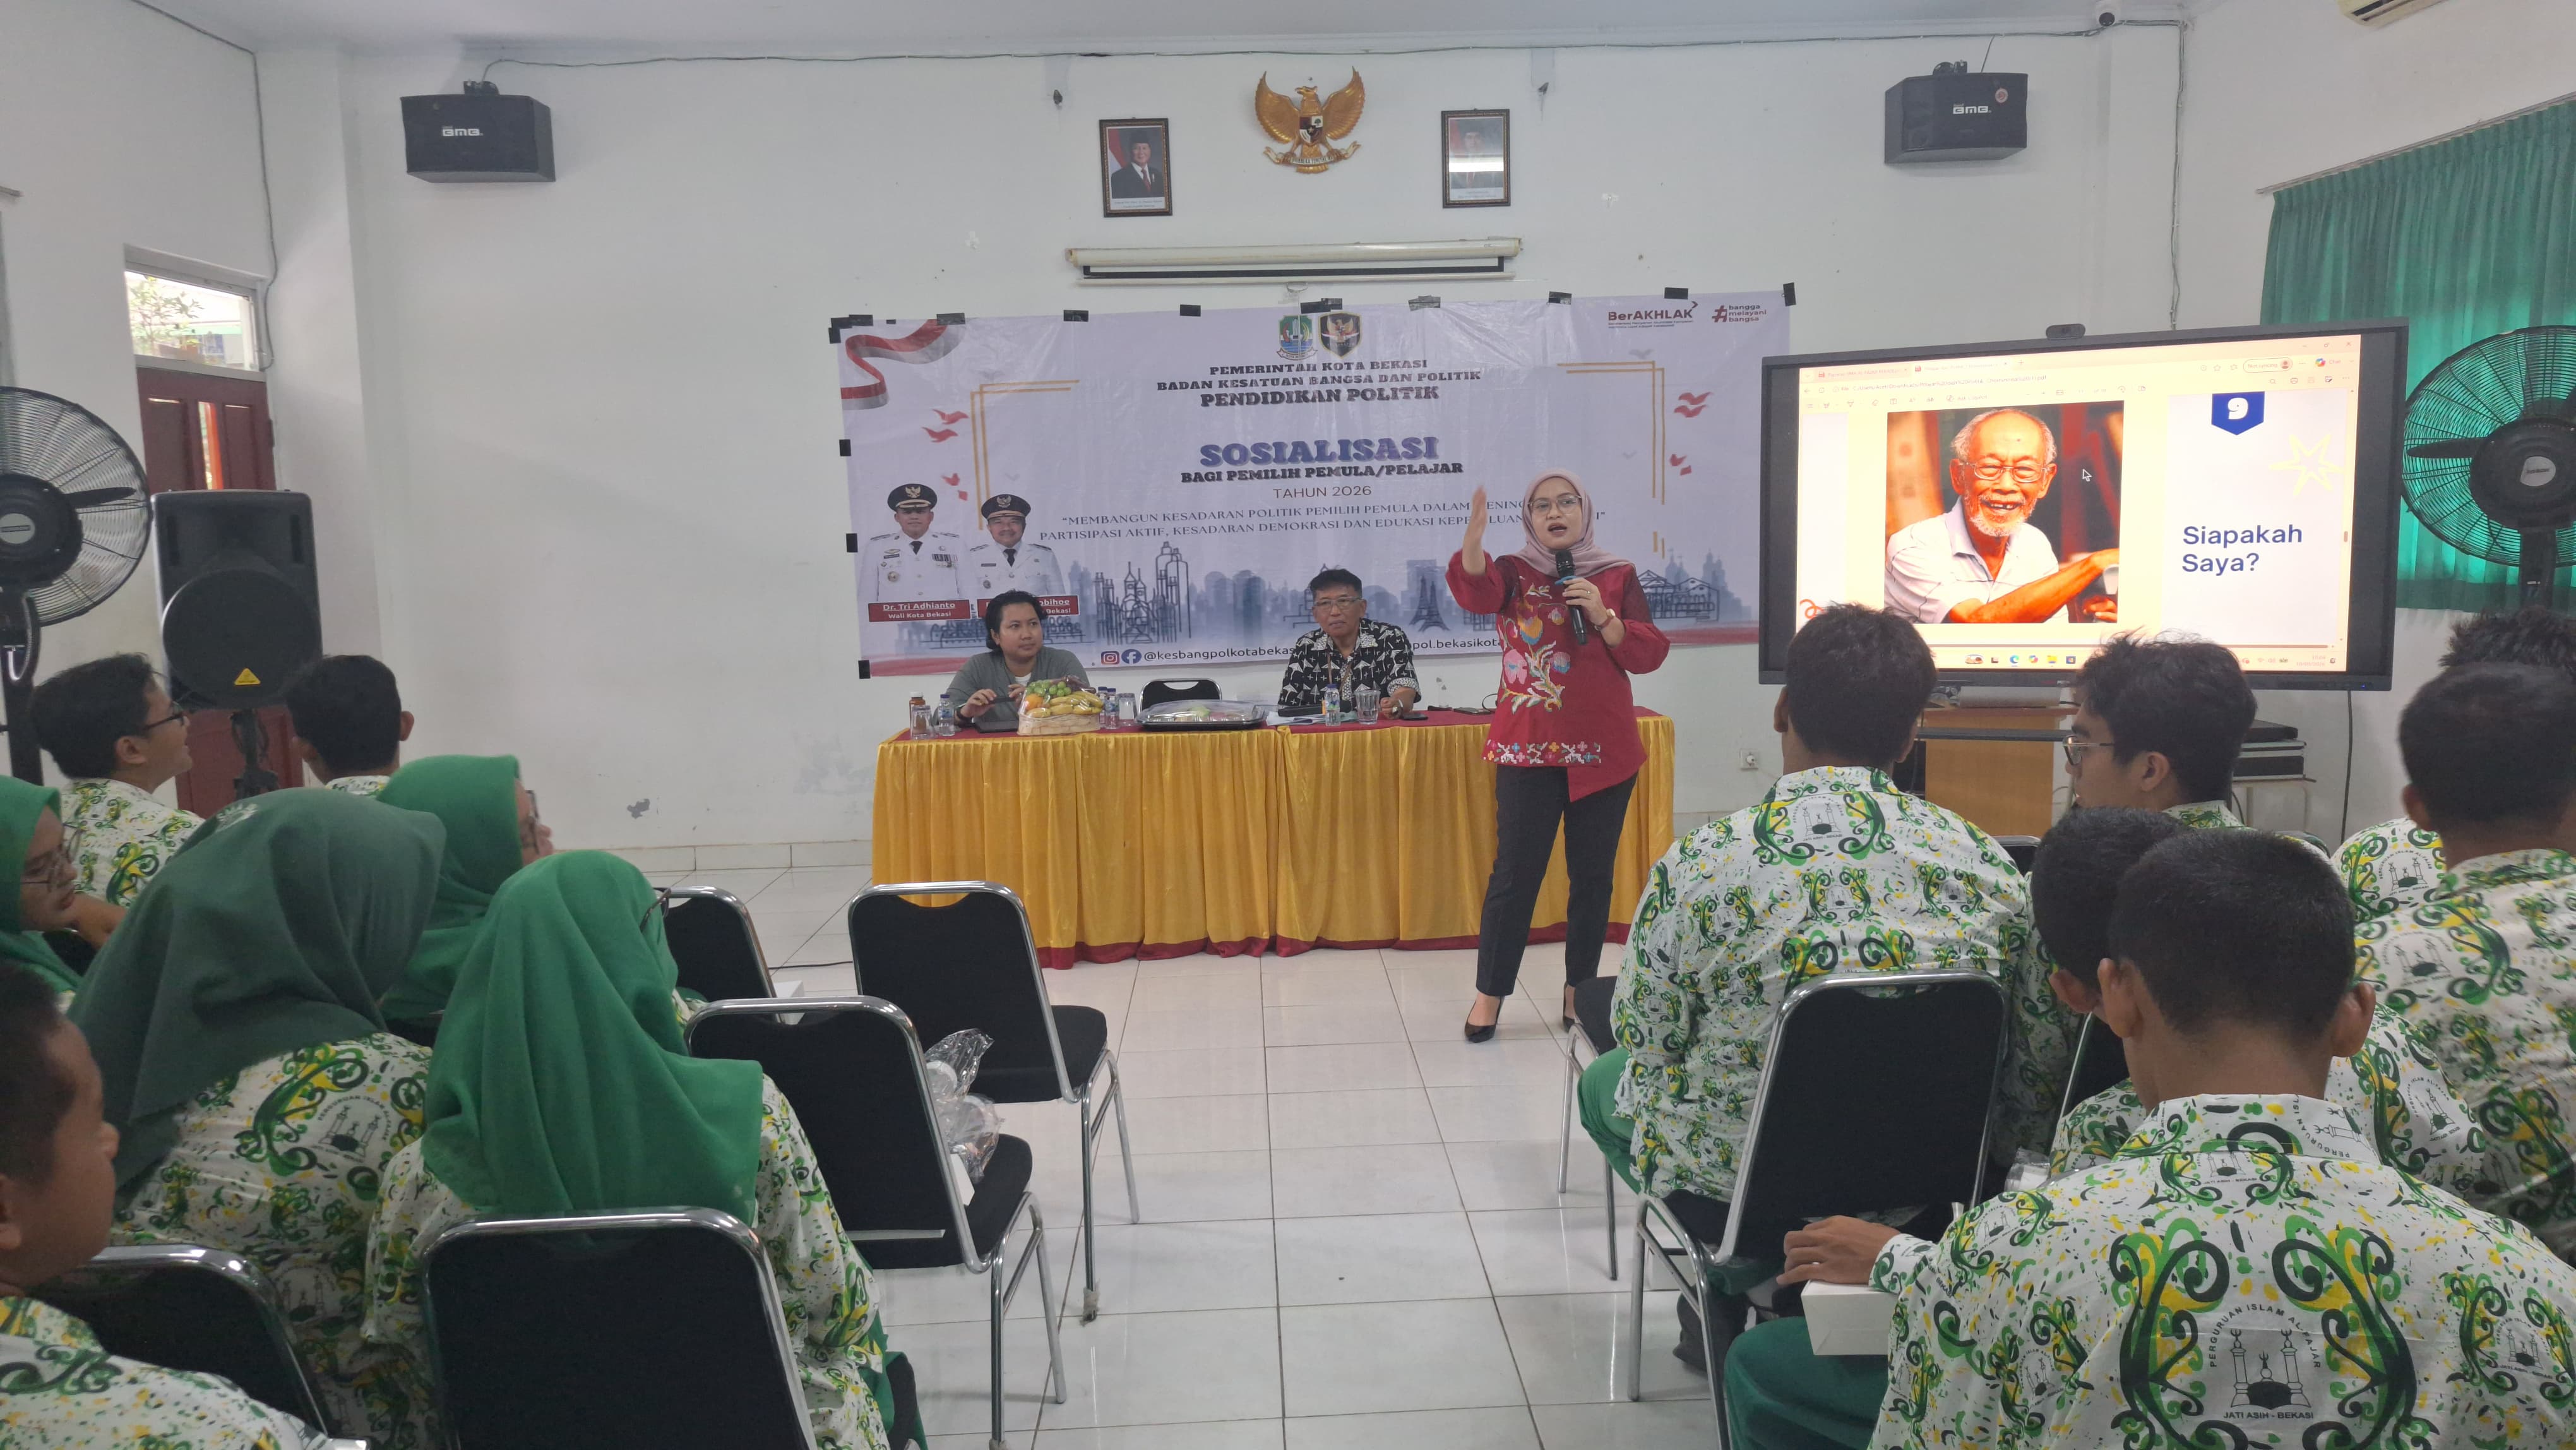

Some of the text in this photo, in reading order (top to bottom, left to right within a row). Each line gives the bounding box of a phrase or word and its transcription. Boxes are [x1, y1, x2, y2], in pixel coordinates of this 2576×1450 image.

[1608, 309, 1693, 321] BerAKHLAK
[1209, 359, 1428, 375] PEMERINTAH KOTA BEKASI
[1157, 371, 1481, 391] BADAN KESATUAN BANGSA DAN POLITIK
[1200, 386, 1440, 407] PENDIDIKAN POLITIK
[2227, 397, 2249, 420] 9
[1200, 436, 1440, 467] SOSIALISASI
[1181, 462, 1464, 483] BAGI PEMILIH PEMULA/PELAJAR
[1272, 486, 1373, 499] TAHUN 2026
[1162, 510, 1244, 522] KESADARAN
[1248, 508, 1302, 518] POLITIK
[1306, 505, 1360, 516] PEMILIH
[1364, 503, 1419, 514] PEMULA
[1423, 501, 1470, 512] DALAM
[1039, 529, 1121, 541] PARTISIPASI
[1125, 527, 1169, 537] AKTIF,
[1173, 524, 1255, 536] KESADARAN
[1258, 520, 1339, 532] DEMOKRASI
[1344, 519, 1371, 529] DAN
[1375, 517, 1434, 528] EDUKASI
[2183, 524, 2303, 548] Siapakah
[2182, 553, 2259, 576] Saya?
[913, 601, 955, 609] Adhianto
[1144, 645, 1295, 661] @kesbangpolkotabekas
[2209, 1303, 2321, 1369] PERGURUAN ISLAM AL-FAJAR
